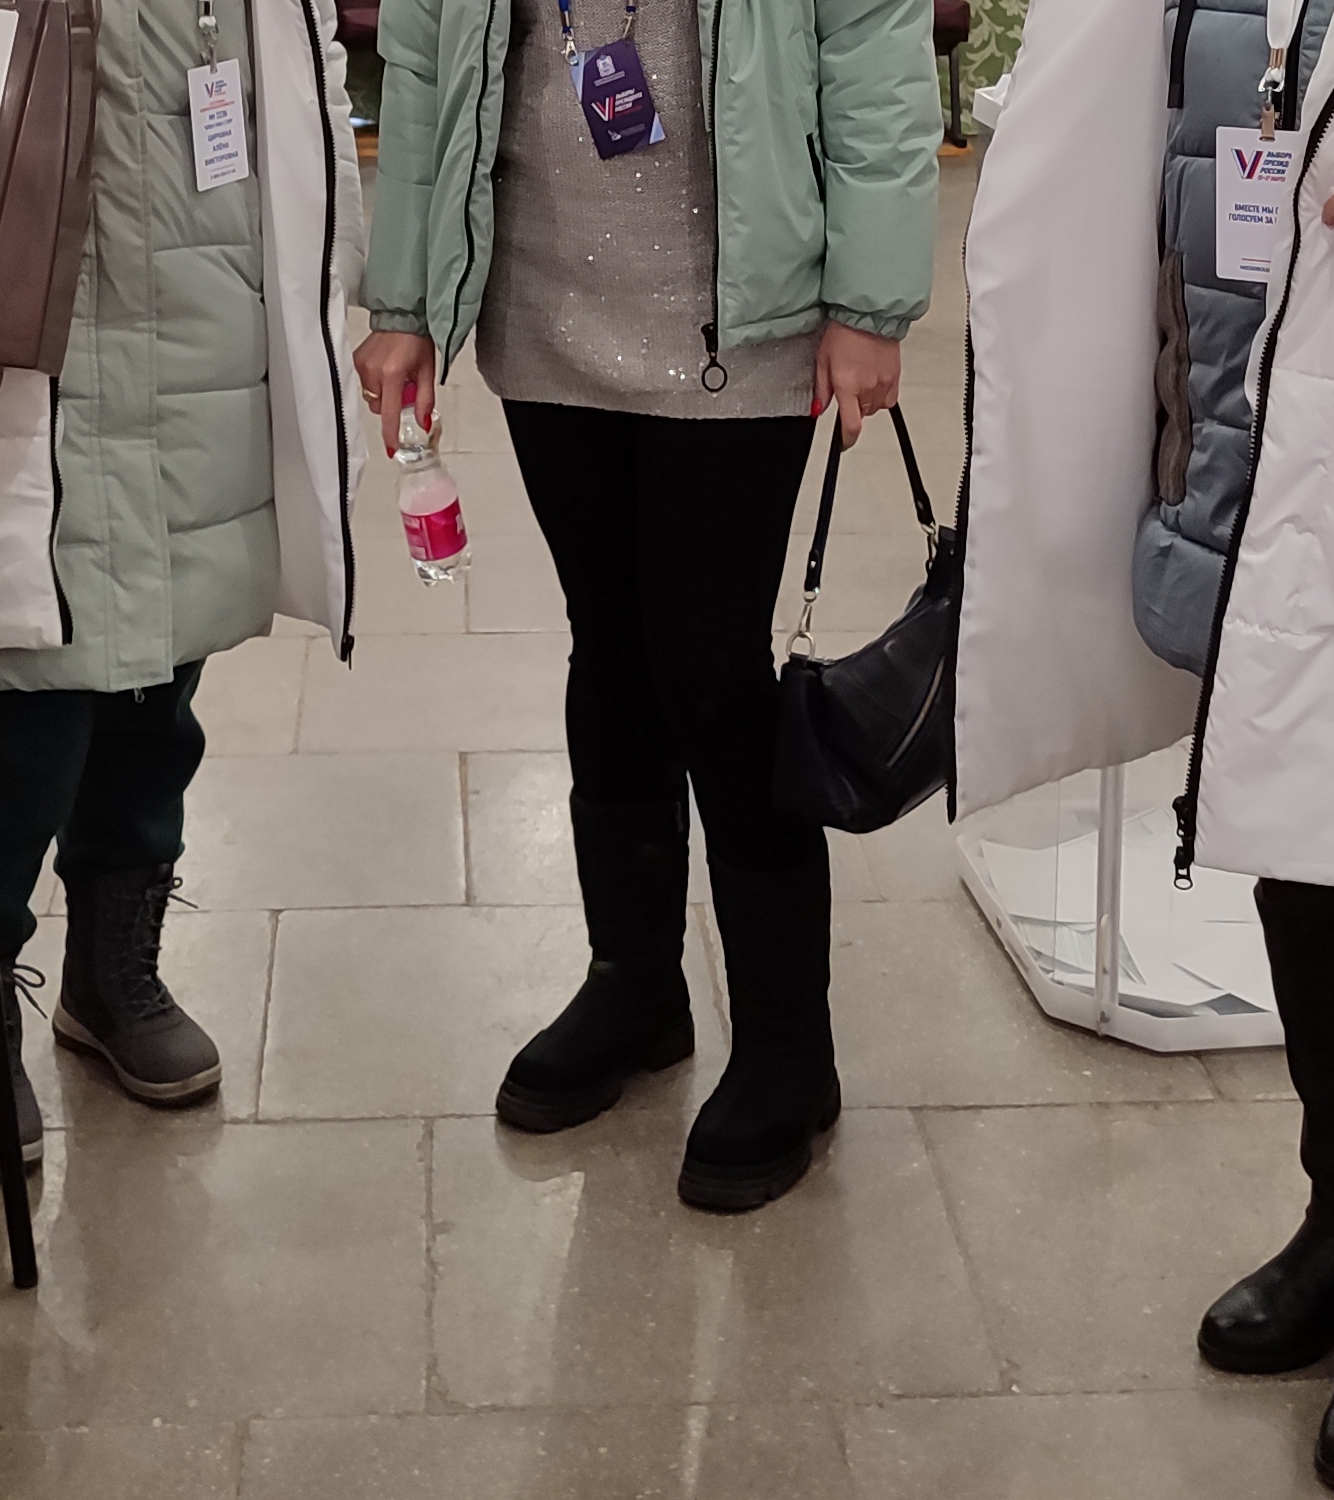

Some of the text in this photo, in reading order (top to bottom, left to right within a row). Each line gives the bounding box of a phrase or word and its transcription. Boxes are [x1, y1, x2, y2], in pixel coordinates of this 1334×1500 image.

[1234, 204, 1274, 215] ВМЕСТЕ МЫ
[1228, 213, 1274, 225] ГОЛОСУЕМ ЗА
